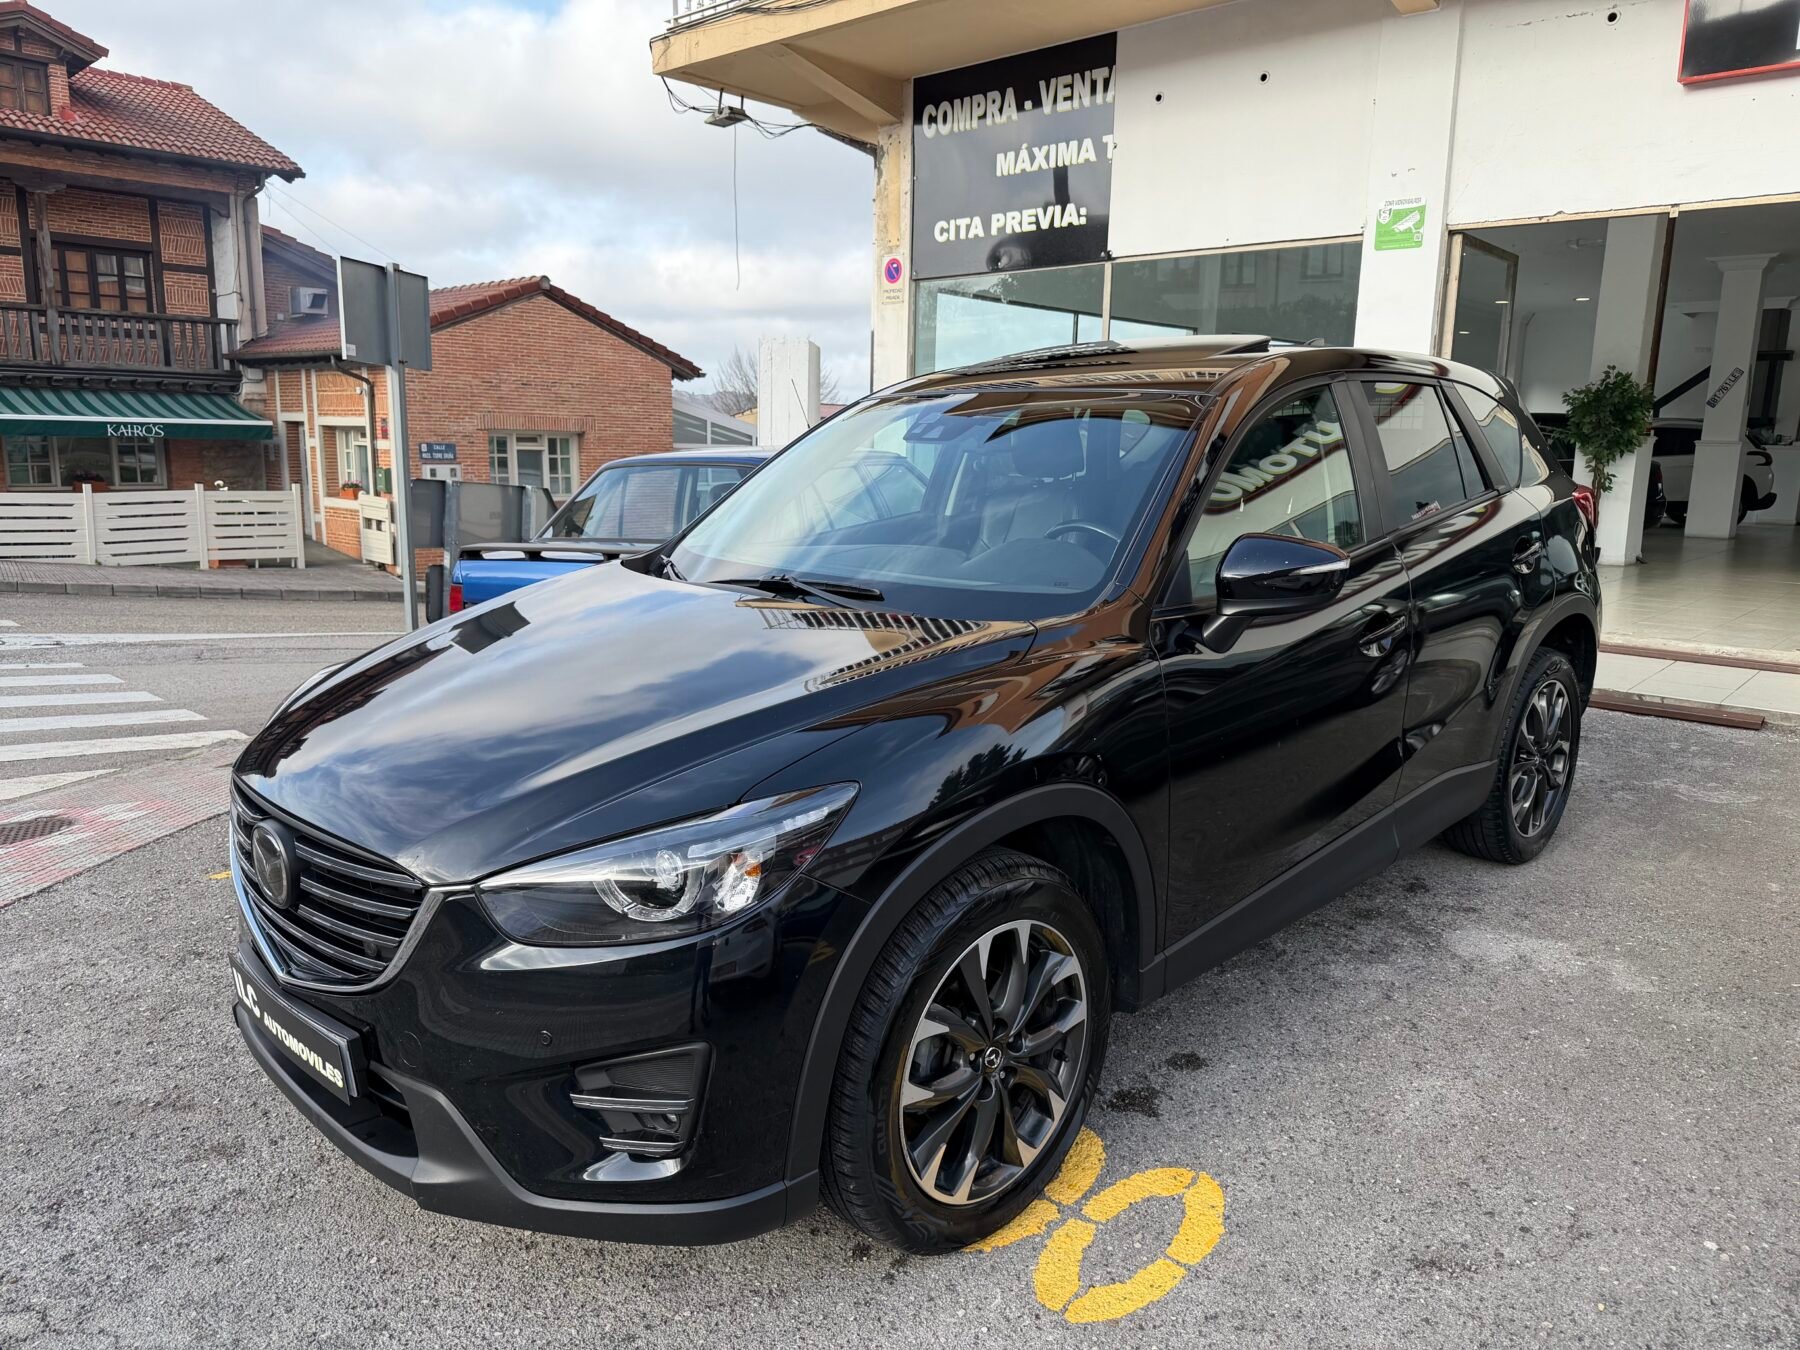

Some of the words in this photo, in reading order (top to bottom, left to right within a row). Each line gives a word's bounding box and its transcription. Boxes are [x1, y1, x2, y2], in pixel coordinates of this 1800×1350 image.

[922, 87, 1018, 138] COMPRA
[996, 138, 1097, 177] MÁXIMA
[934, 216, 985, 242] CITA
[991, 203, 1088, 236] PREVIA:
[263, 1011, 344, 1088] AUTOMOVILES
